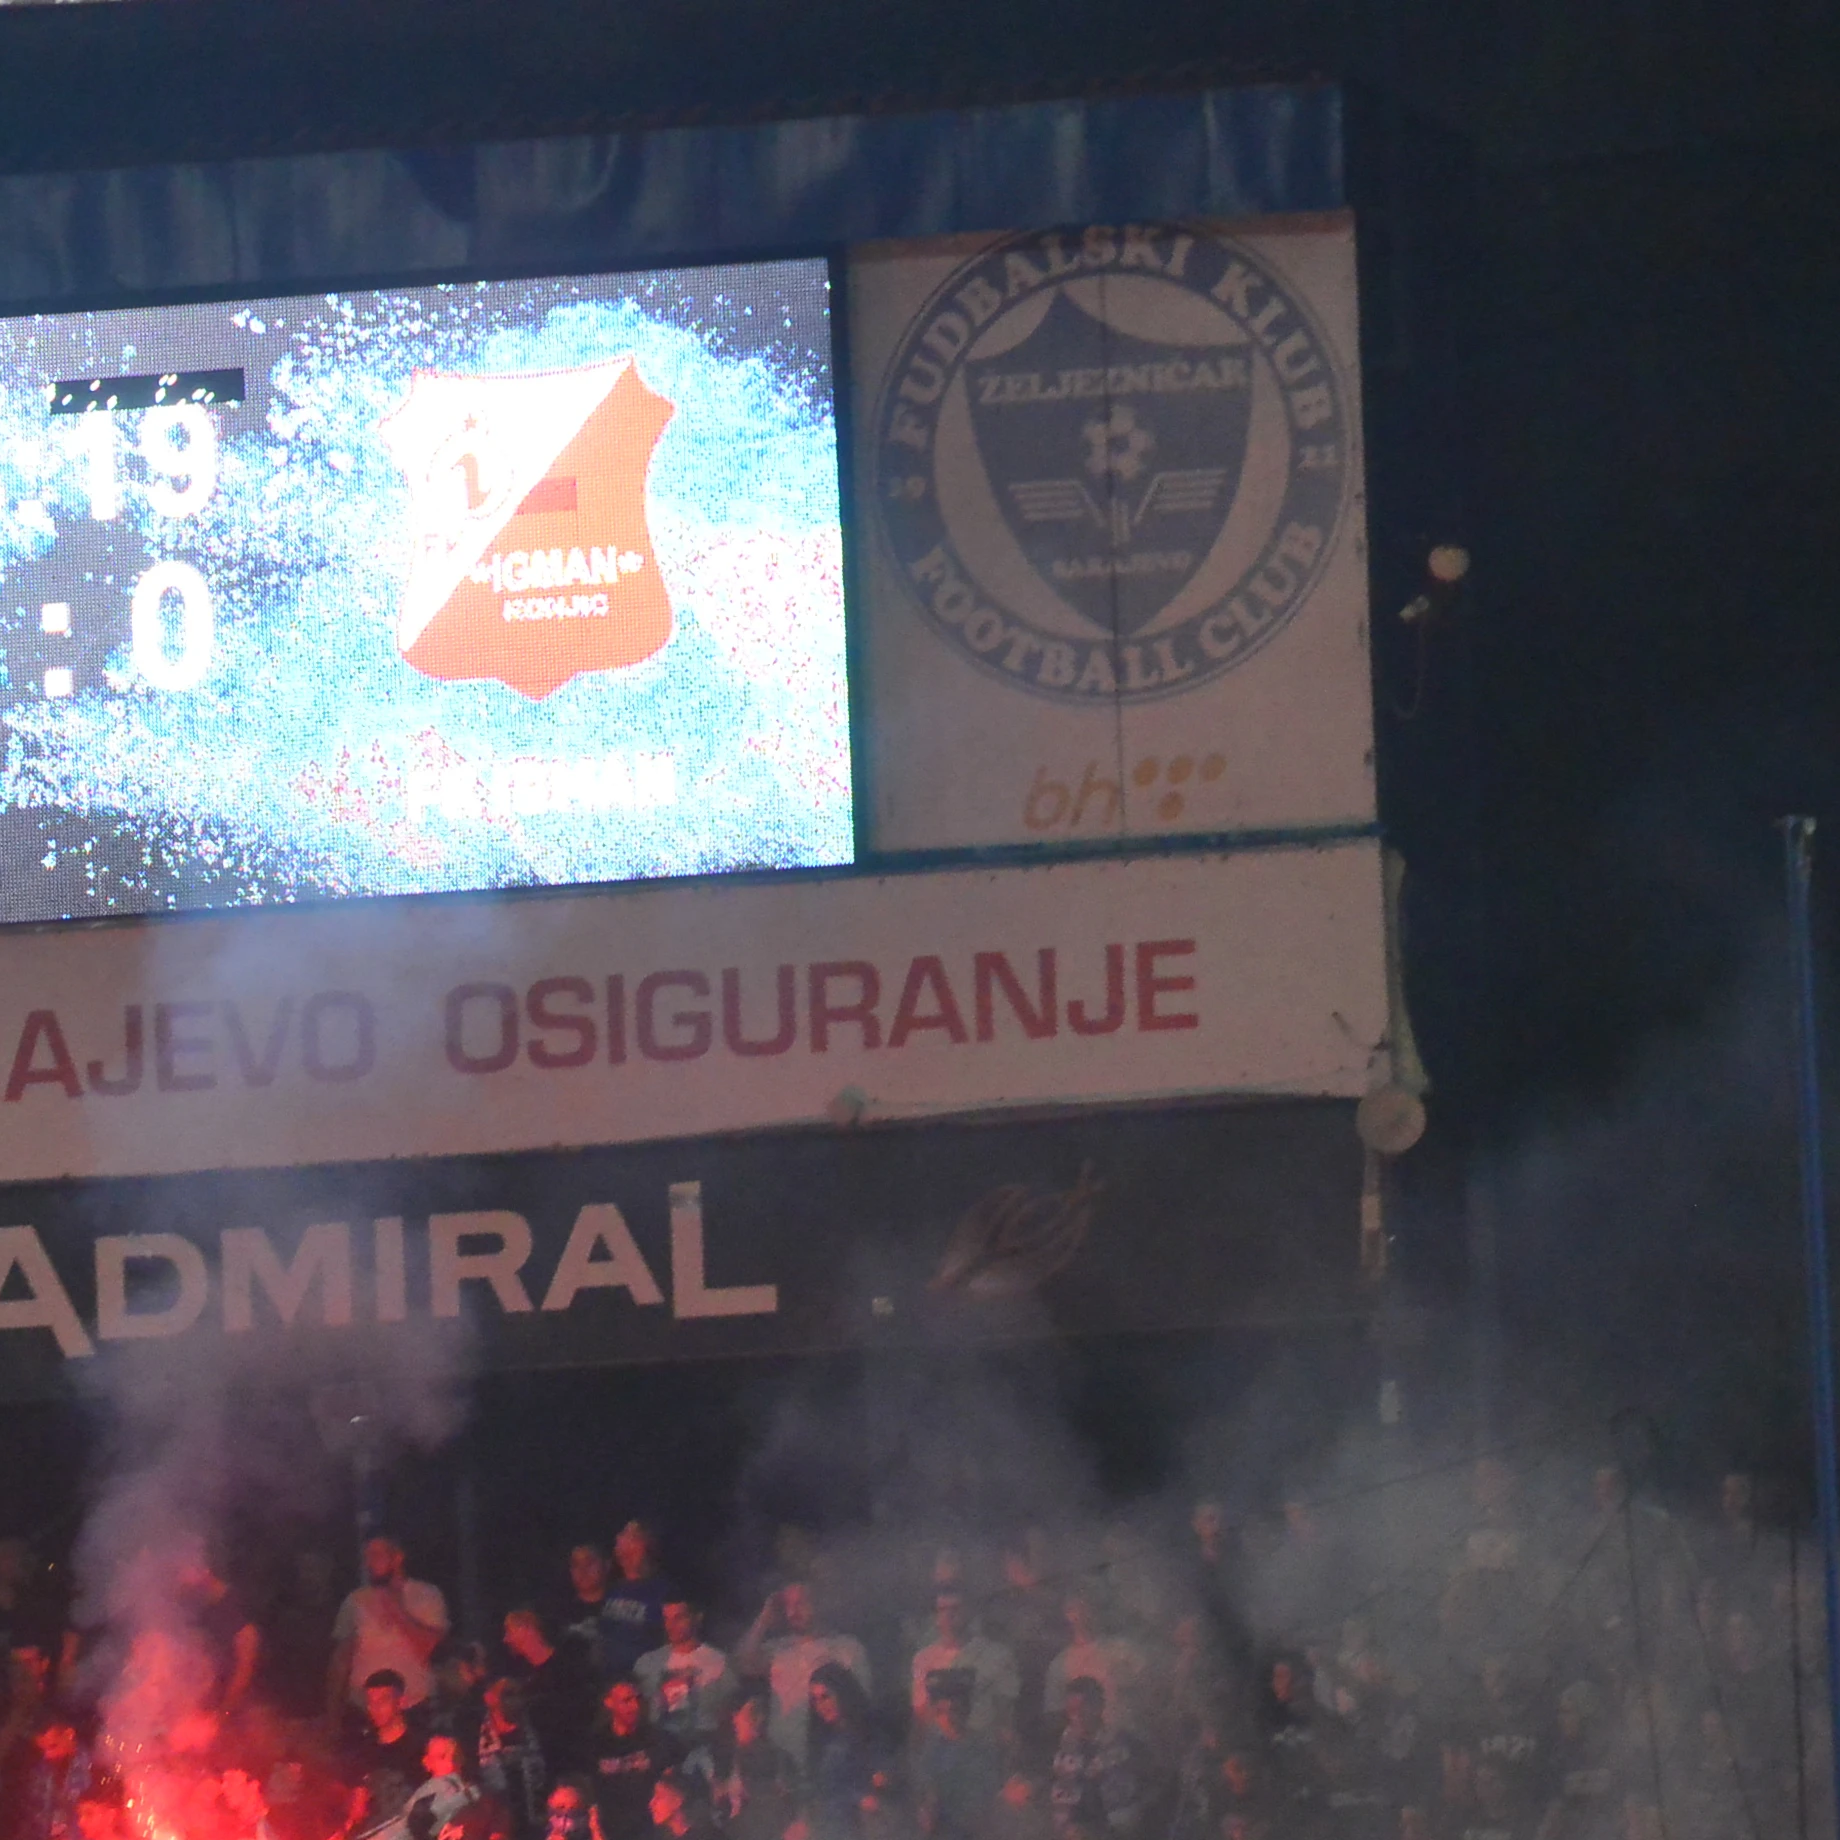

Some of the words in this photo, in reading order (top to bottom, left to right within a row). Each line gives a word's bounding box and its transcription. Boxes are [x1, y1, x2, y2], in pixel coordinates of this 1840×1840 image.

[889, 224, 1194, 450] FUDBALSKI
[1211, 263, 1337, 428] KLUB
[911, 545, 1194, 693] FOOTBALL
[1202, 522, 1325, 658] CLUB
[443, 939, 1200, 1075] OSIGURANJE
